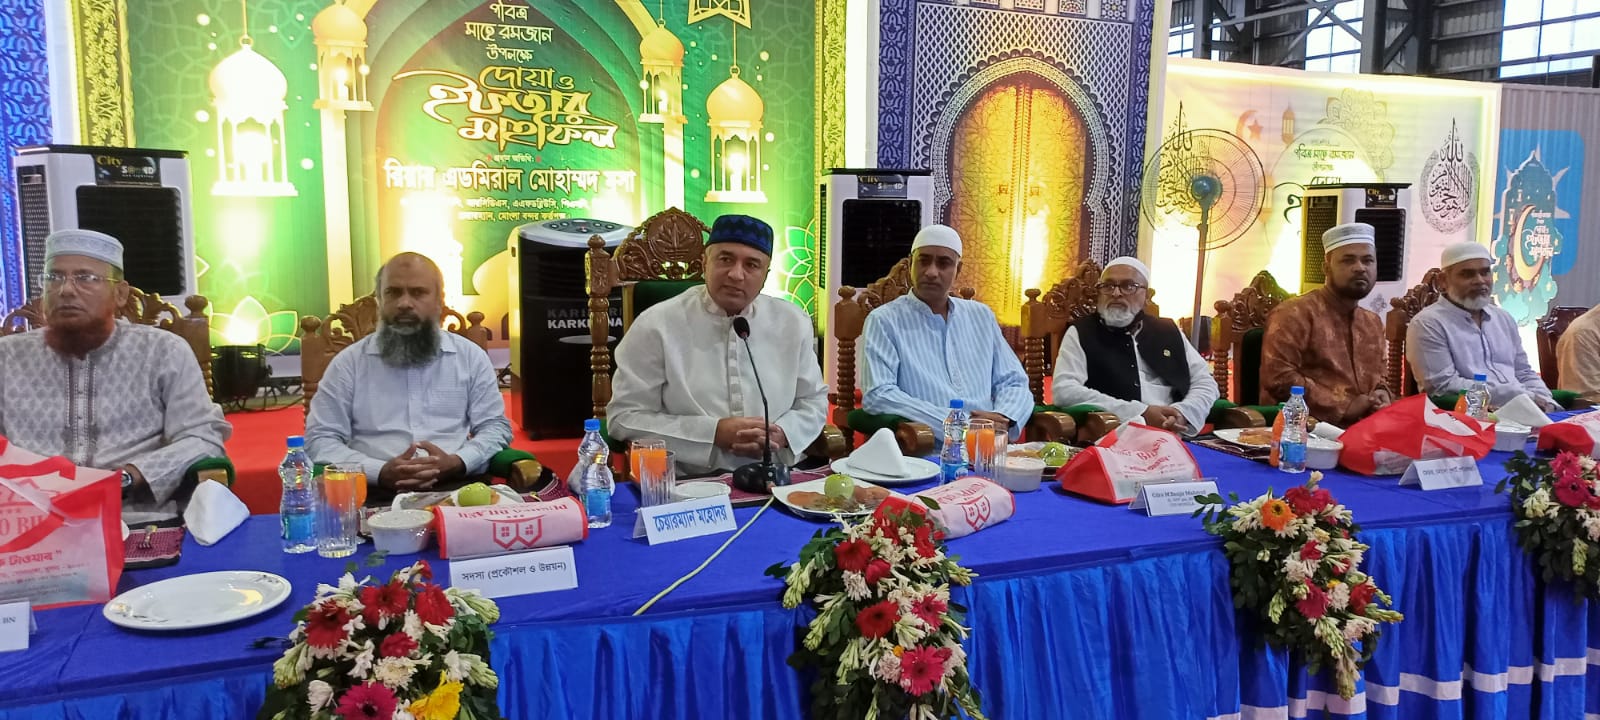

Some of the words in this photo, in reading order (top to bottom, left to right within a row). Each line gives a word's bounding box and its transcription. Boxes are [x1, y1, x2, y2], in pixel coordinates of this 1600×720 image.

[465, 22, 497, 41] মাহে
[498, 24, 554, 45] রমজান
[486, 44, 534, 63] উপলক্ষে
[478, 65, 556, 91] দোয়া
[557, 76, 575, 91] ও
[457, 112, 619, 152] মাহফিল
[96, 155, 122, 168] City
[445, 159, 522, 192] এডমিরাল
[529, 166, 601, 195] মোহাম্মদ
[547, 318, 623, 329] KARKNA
[653, 510, 697, 532] চেয়ারম্যান
[696, 504, 728, 525] মহোদয়
[461, 571, 485, 581] সদস্য
[529, 565, 536, 573] ও
